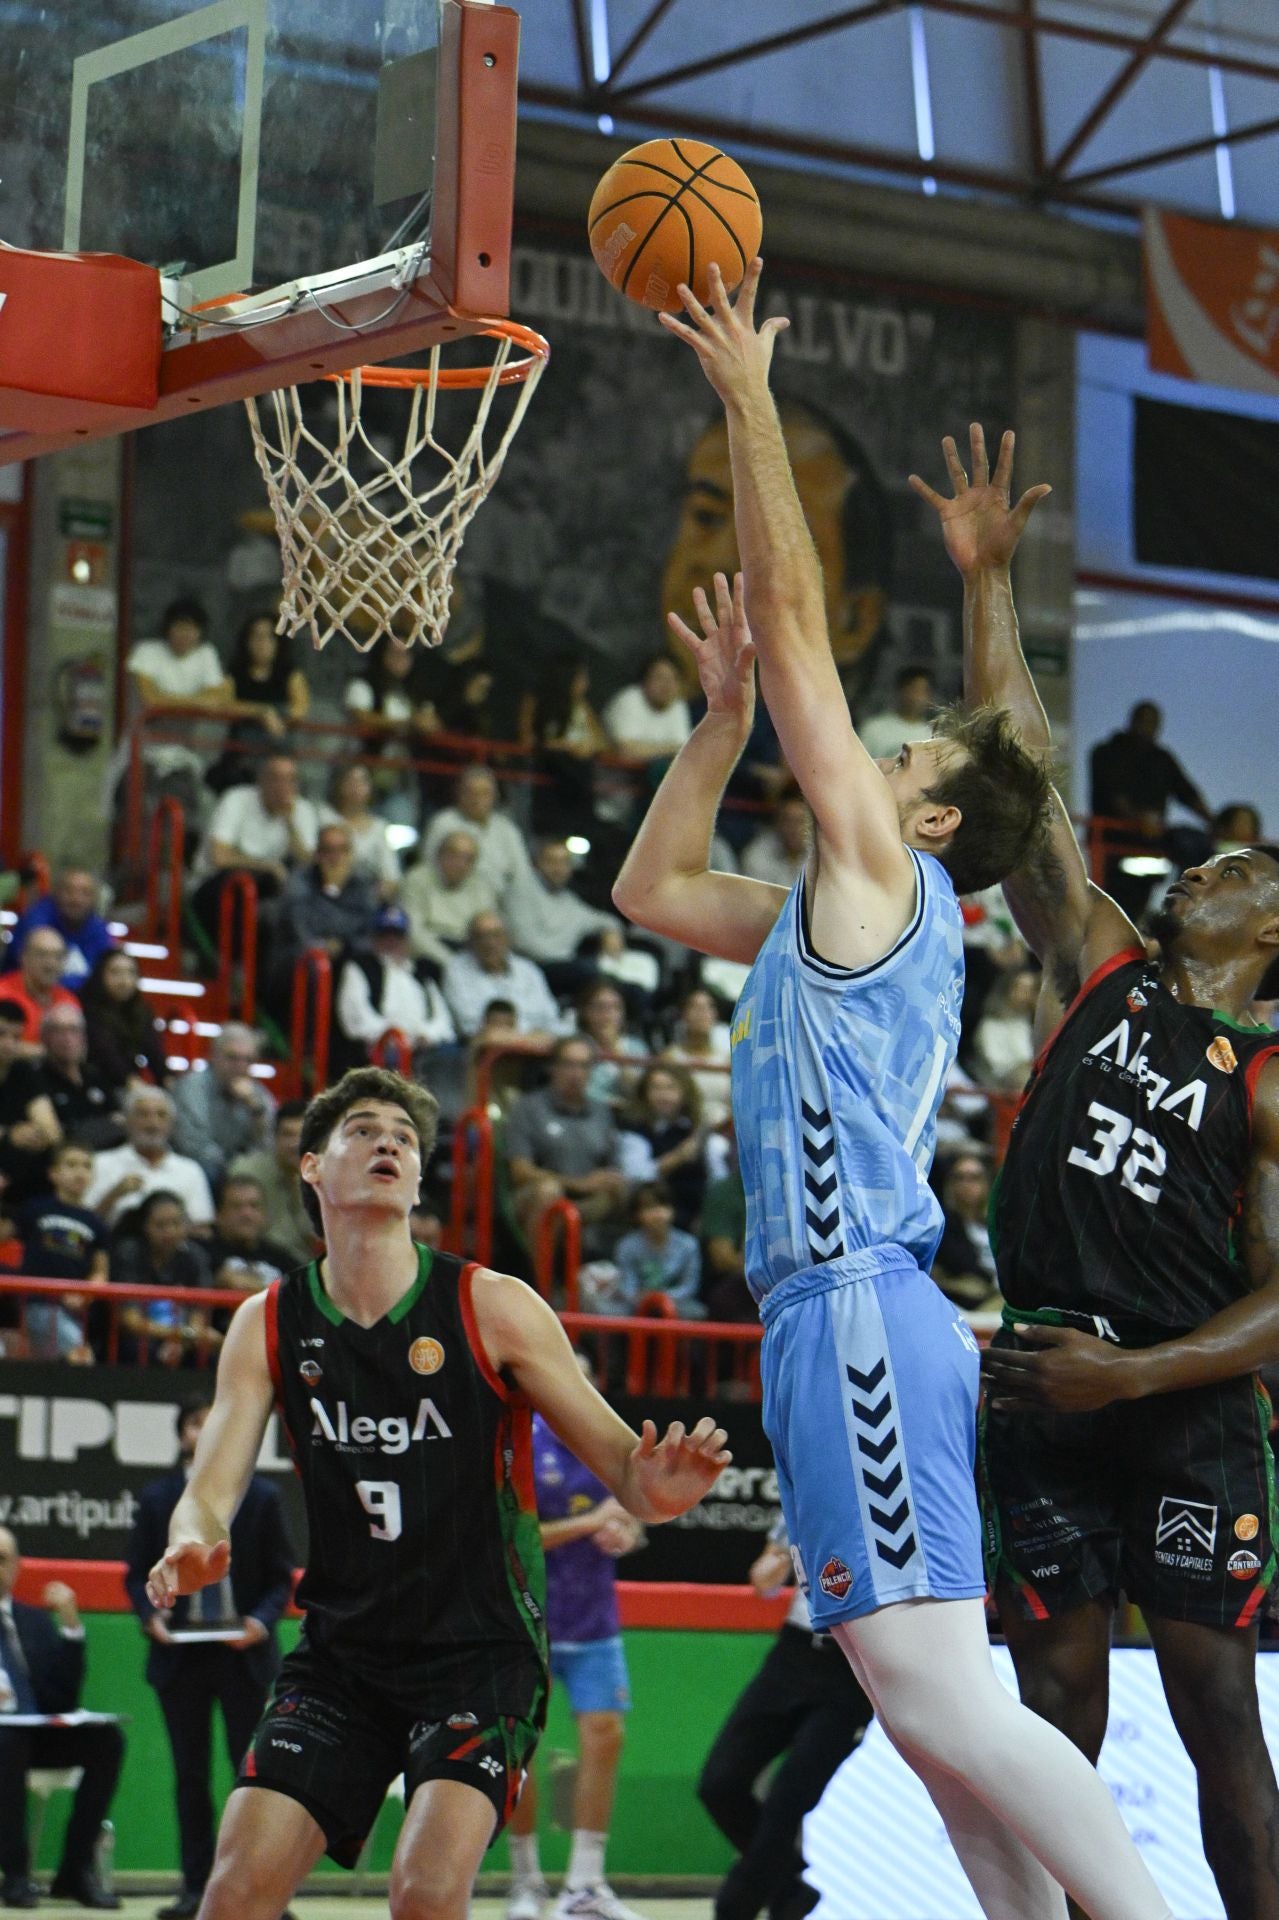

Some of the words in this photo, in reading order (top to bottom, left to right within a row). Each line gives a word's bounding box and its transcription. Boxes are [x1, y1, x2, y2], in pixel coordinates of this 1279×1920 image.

[1100, 1060, 1113, 1073] tu
[1067, 1101, 1167, 1205] 32
[356, 1479, 402, 1542] 9
[1031, 1564, 1060, 1578] vive
[1180, 1555, 1213, 1571] CAPITALES
[822, 1571, 852, 1588] PALENCIA
[271, 1738, 303, 1753] vive
